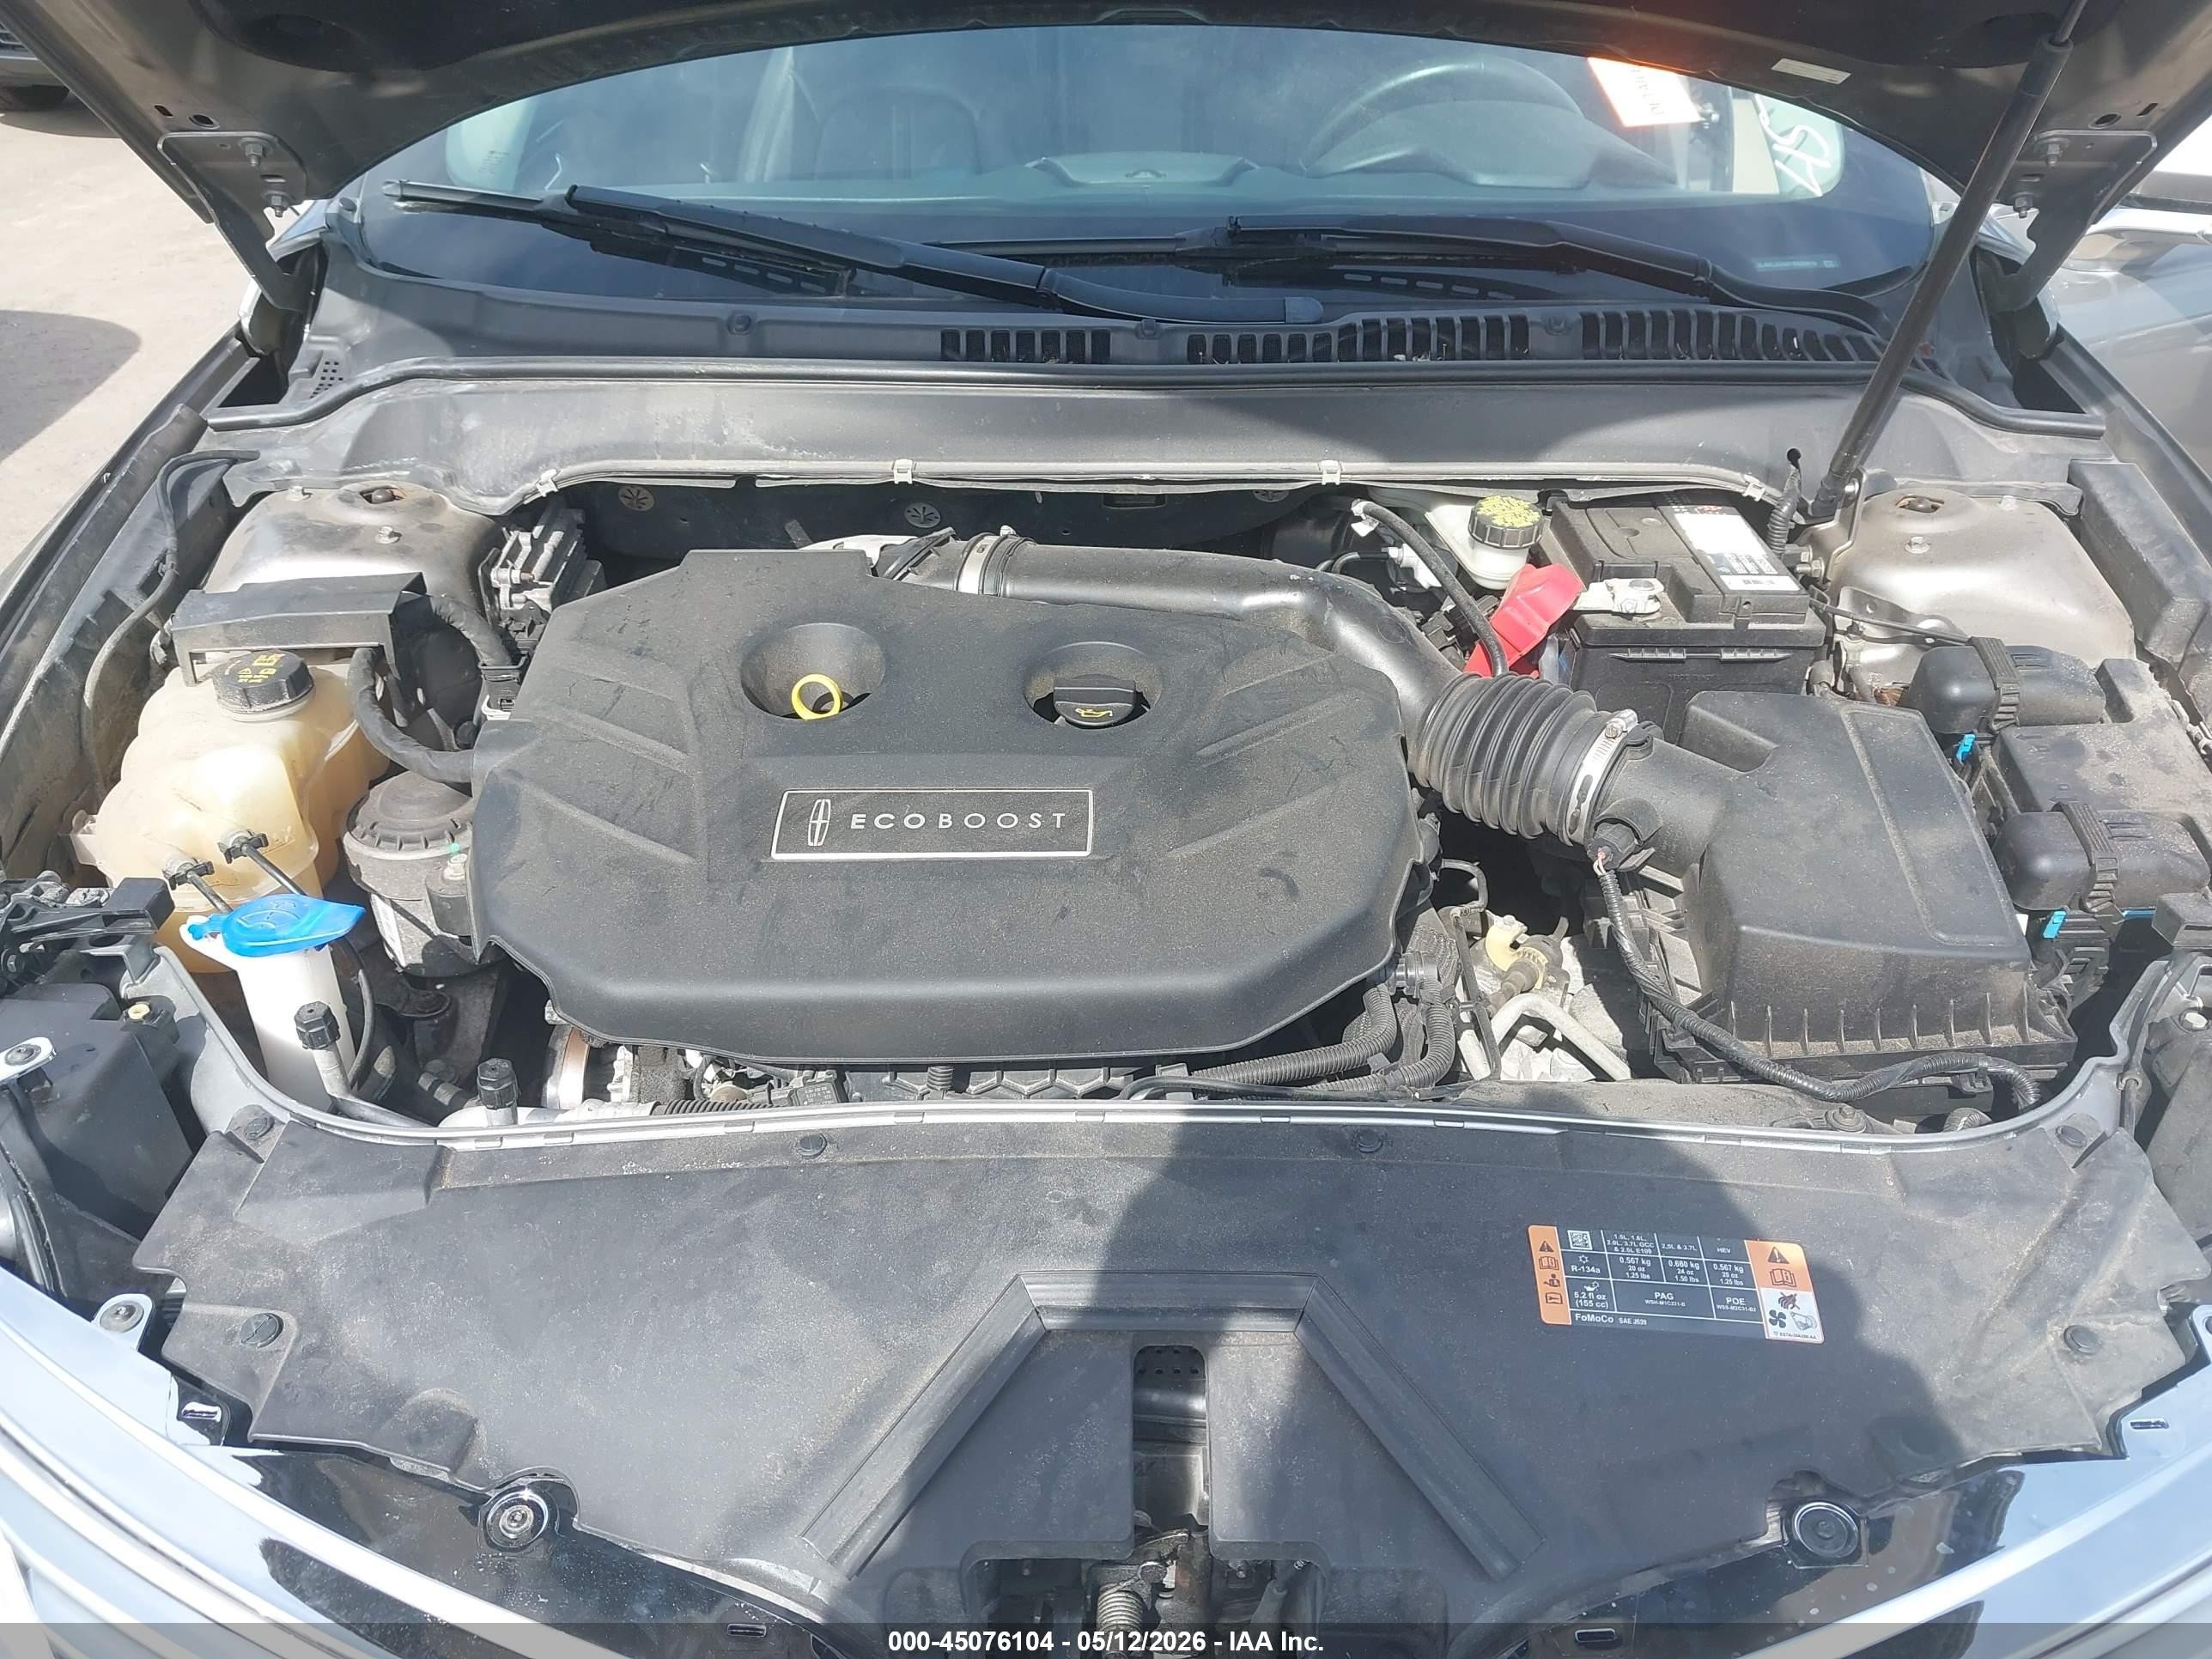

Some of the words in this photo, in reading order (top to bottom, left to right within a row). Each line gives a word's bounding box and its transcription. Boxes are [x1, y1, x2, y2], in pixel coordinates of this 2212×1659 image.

[849, 812, 1066, 830] ECOBOOST
[1641, 1258, 1651, 1267] kg
[1690, 1261, 1700, 1270] kg
[1571, 1265, 1601, 1273] R-134a
[1734, 1265, 1744, 1273] kg
[1654, 1291, 1674, 1300] PAG
[1575, 1299, 1594, 1308] (155
[1595, 1301, 1608, 1310] cc)
[1726, 1297, 1746, 1305] POE
[1575, 1313, 1614, 1323] FoMoCo
